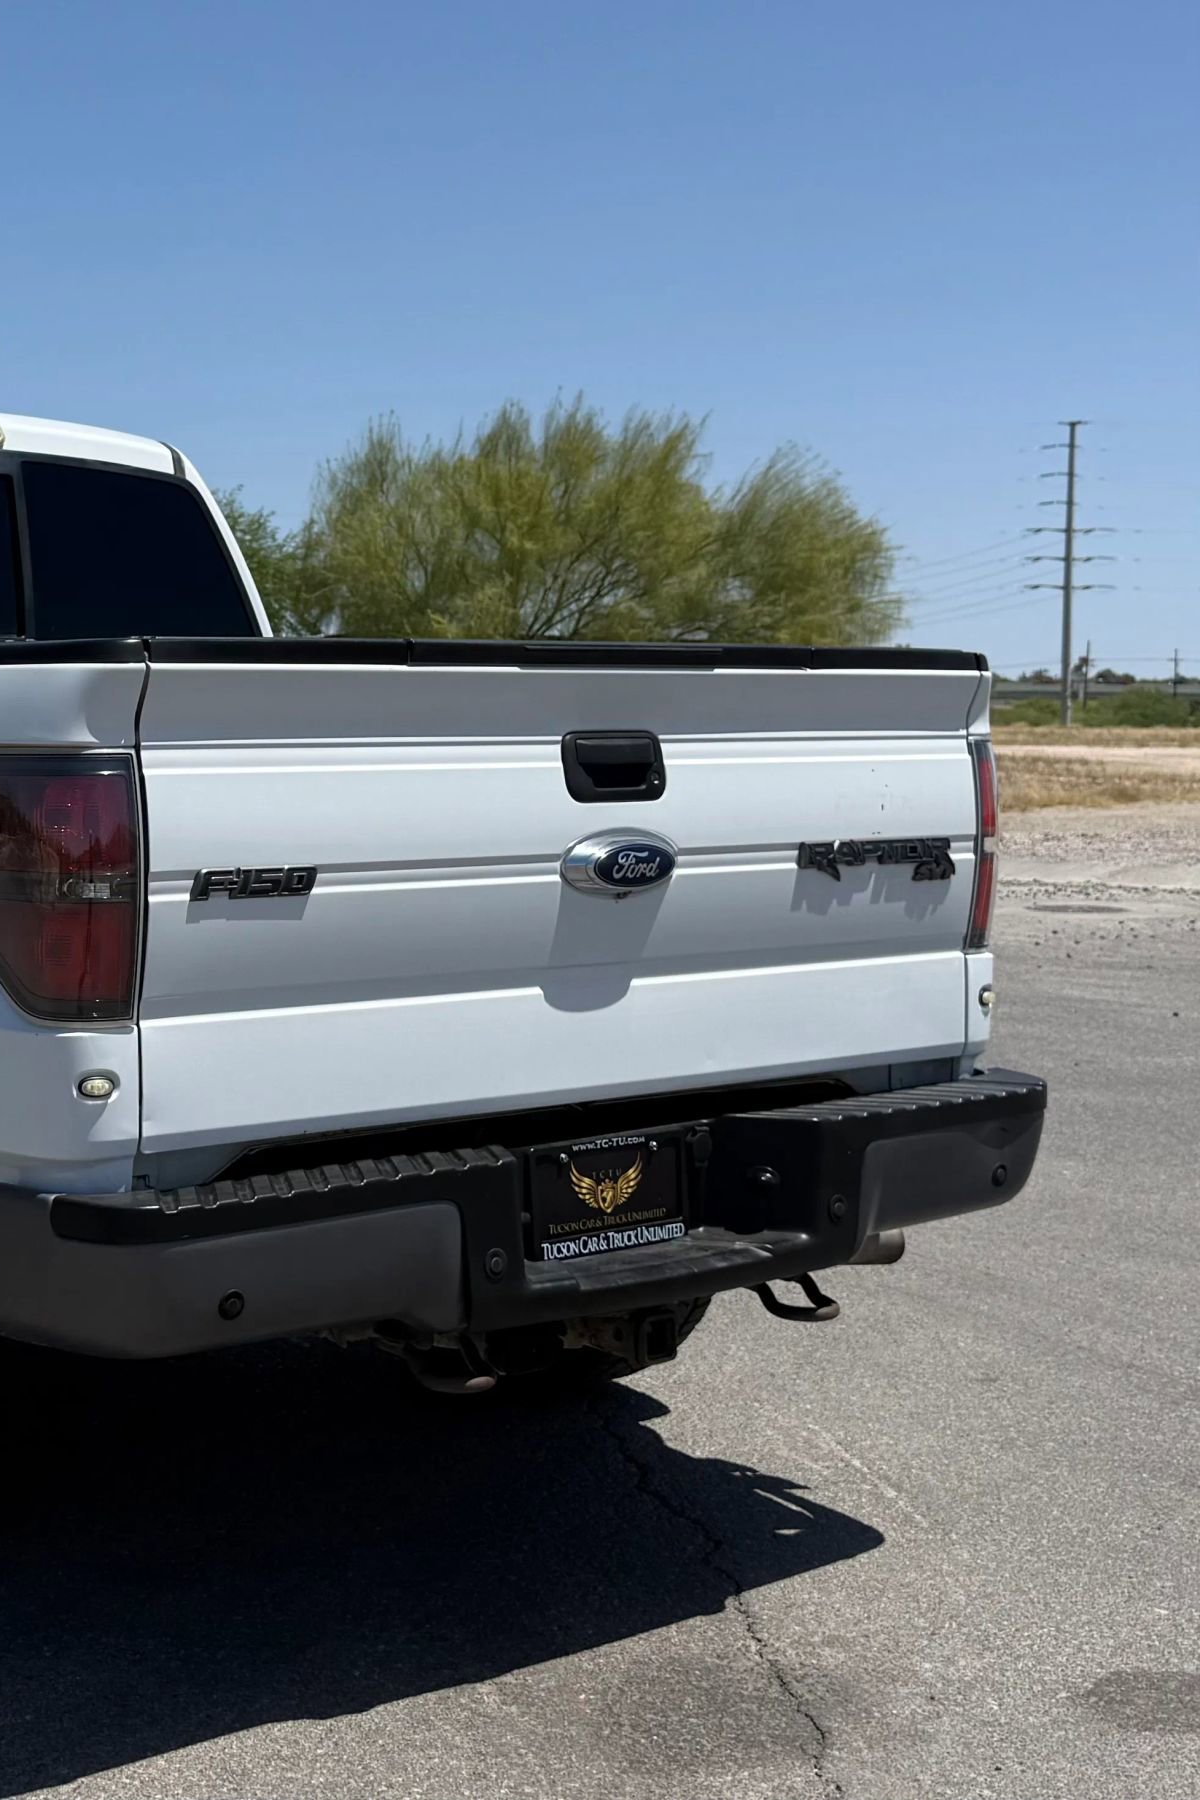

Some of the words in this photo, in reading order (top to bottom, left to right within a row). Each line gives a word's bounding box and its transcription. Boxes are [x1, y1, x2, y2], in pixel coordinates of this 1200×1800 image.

[612, 850, 660, 879] Ford
[797, 838, 955, 881] RAPTOR
[190, 866, 318, 902] F-150
[541, 1240, 580, 1261] TUCSON
[580, 1236, 599, 1254] CAR
[599, 1232, 608, 1251] &
[607, 1228, 638, 1249] TRUCK
[638, 1223, 685, 1243] UNLIMITED
